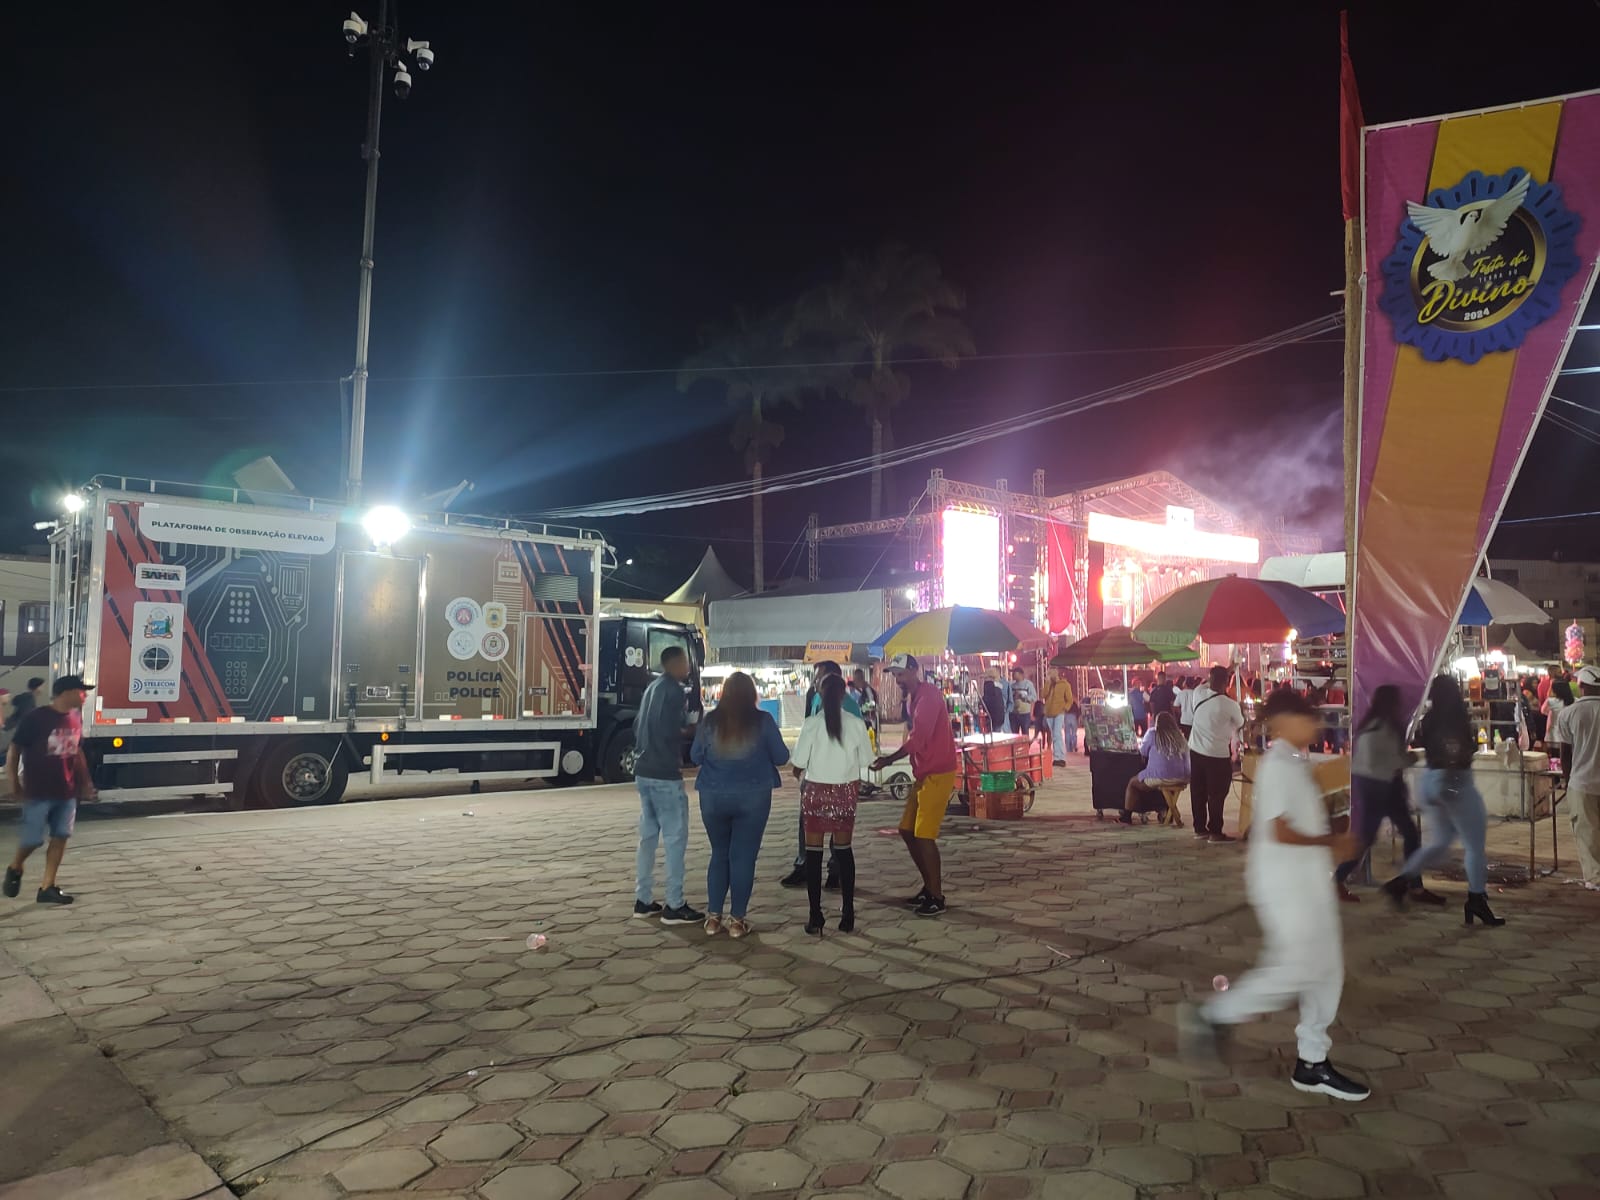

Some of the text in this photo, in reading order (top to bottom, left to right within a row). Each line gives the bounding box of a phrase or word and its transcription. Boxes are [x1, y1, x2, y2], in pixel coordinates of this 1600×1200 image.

[1470, 255, 1506, 278] Festa
[1418, 277, 1534, 323] Divino
[1463, 307, 1490, 321] 2024
[151, 520, 213, 532] PLATAFORMA
[228, 527, 286, 539] OBSERVAÇÃO
[288, 533, 325, 542] ELEVADA
[141, 570, 180, 581] BAHIA
[447, 669, 503, 682] POLÍCIA
[449, 687, 501, 698] POLICE
